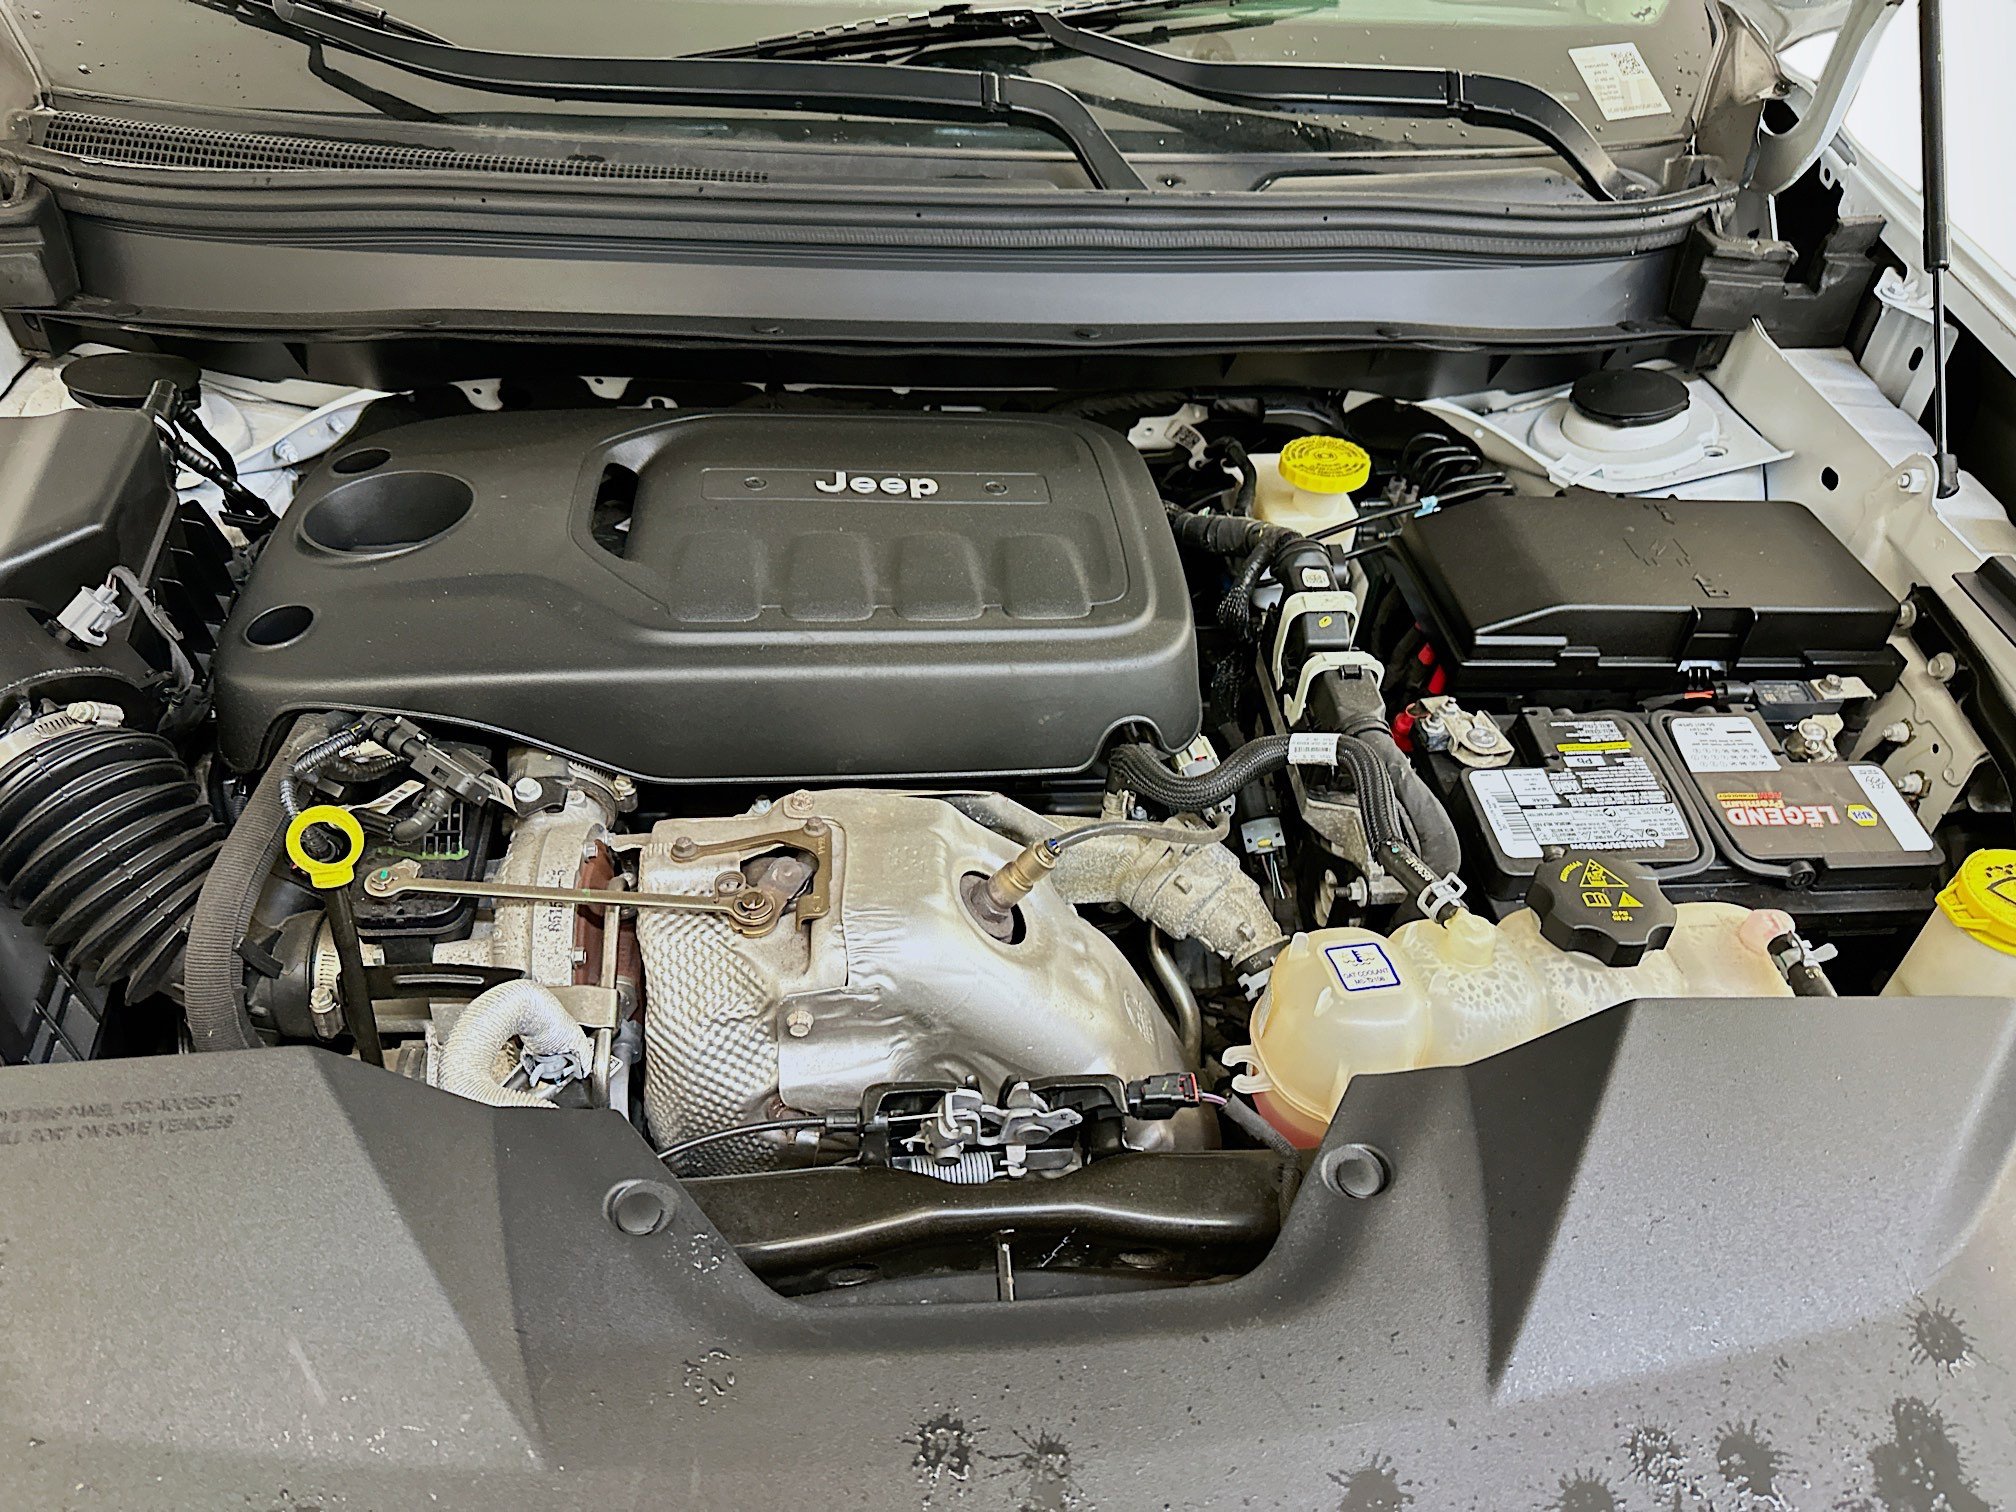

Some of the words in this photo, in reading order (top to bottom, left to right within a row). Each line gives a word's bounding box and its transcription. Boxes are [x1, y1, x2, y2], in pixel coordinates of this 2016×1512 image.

[815, 471, 939, 499] Jeep
[1576, 757, 1593, 765] Pb
[1720, 799, 1784, 809] Premium
[1725, 805, 1840, 827] LEGEND
[1851, 811, 1874, 820] NAPA
[1357, 967, 1389, 979] COOLANT
